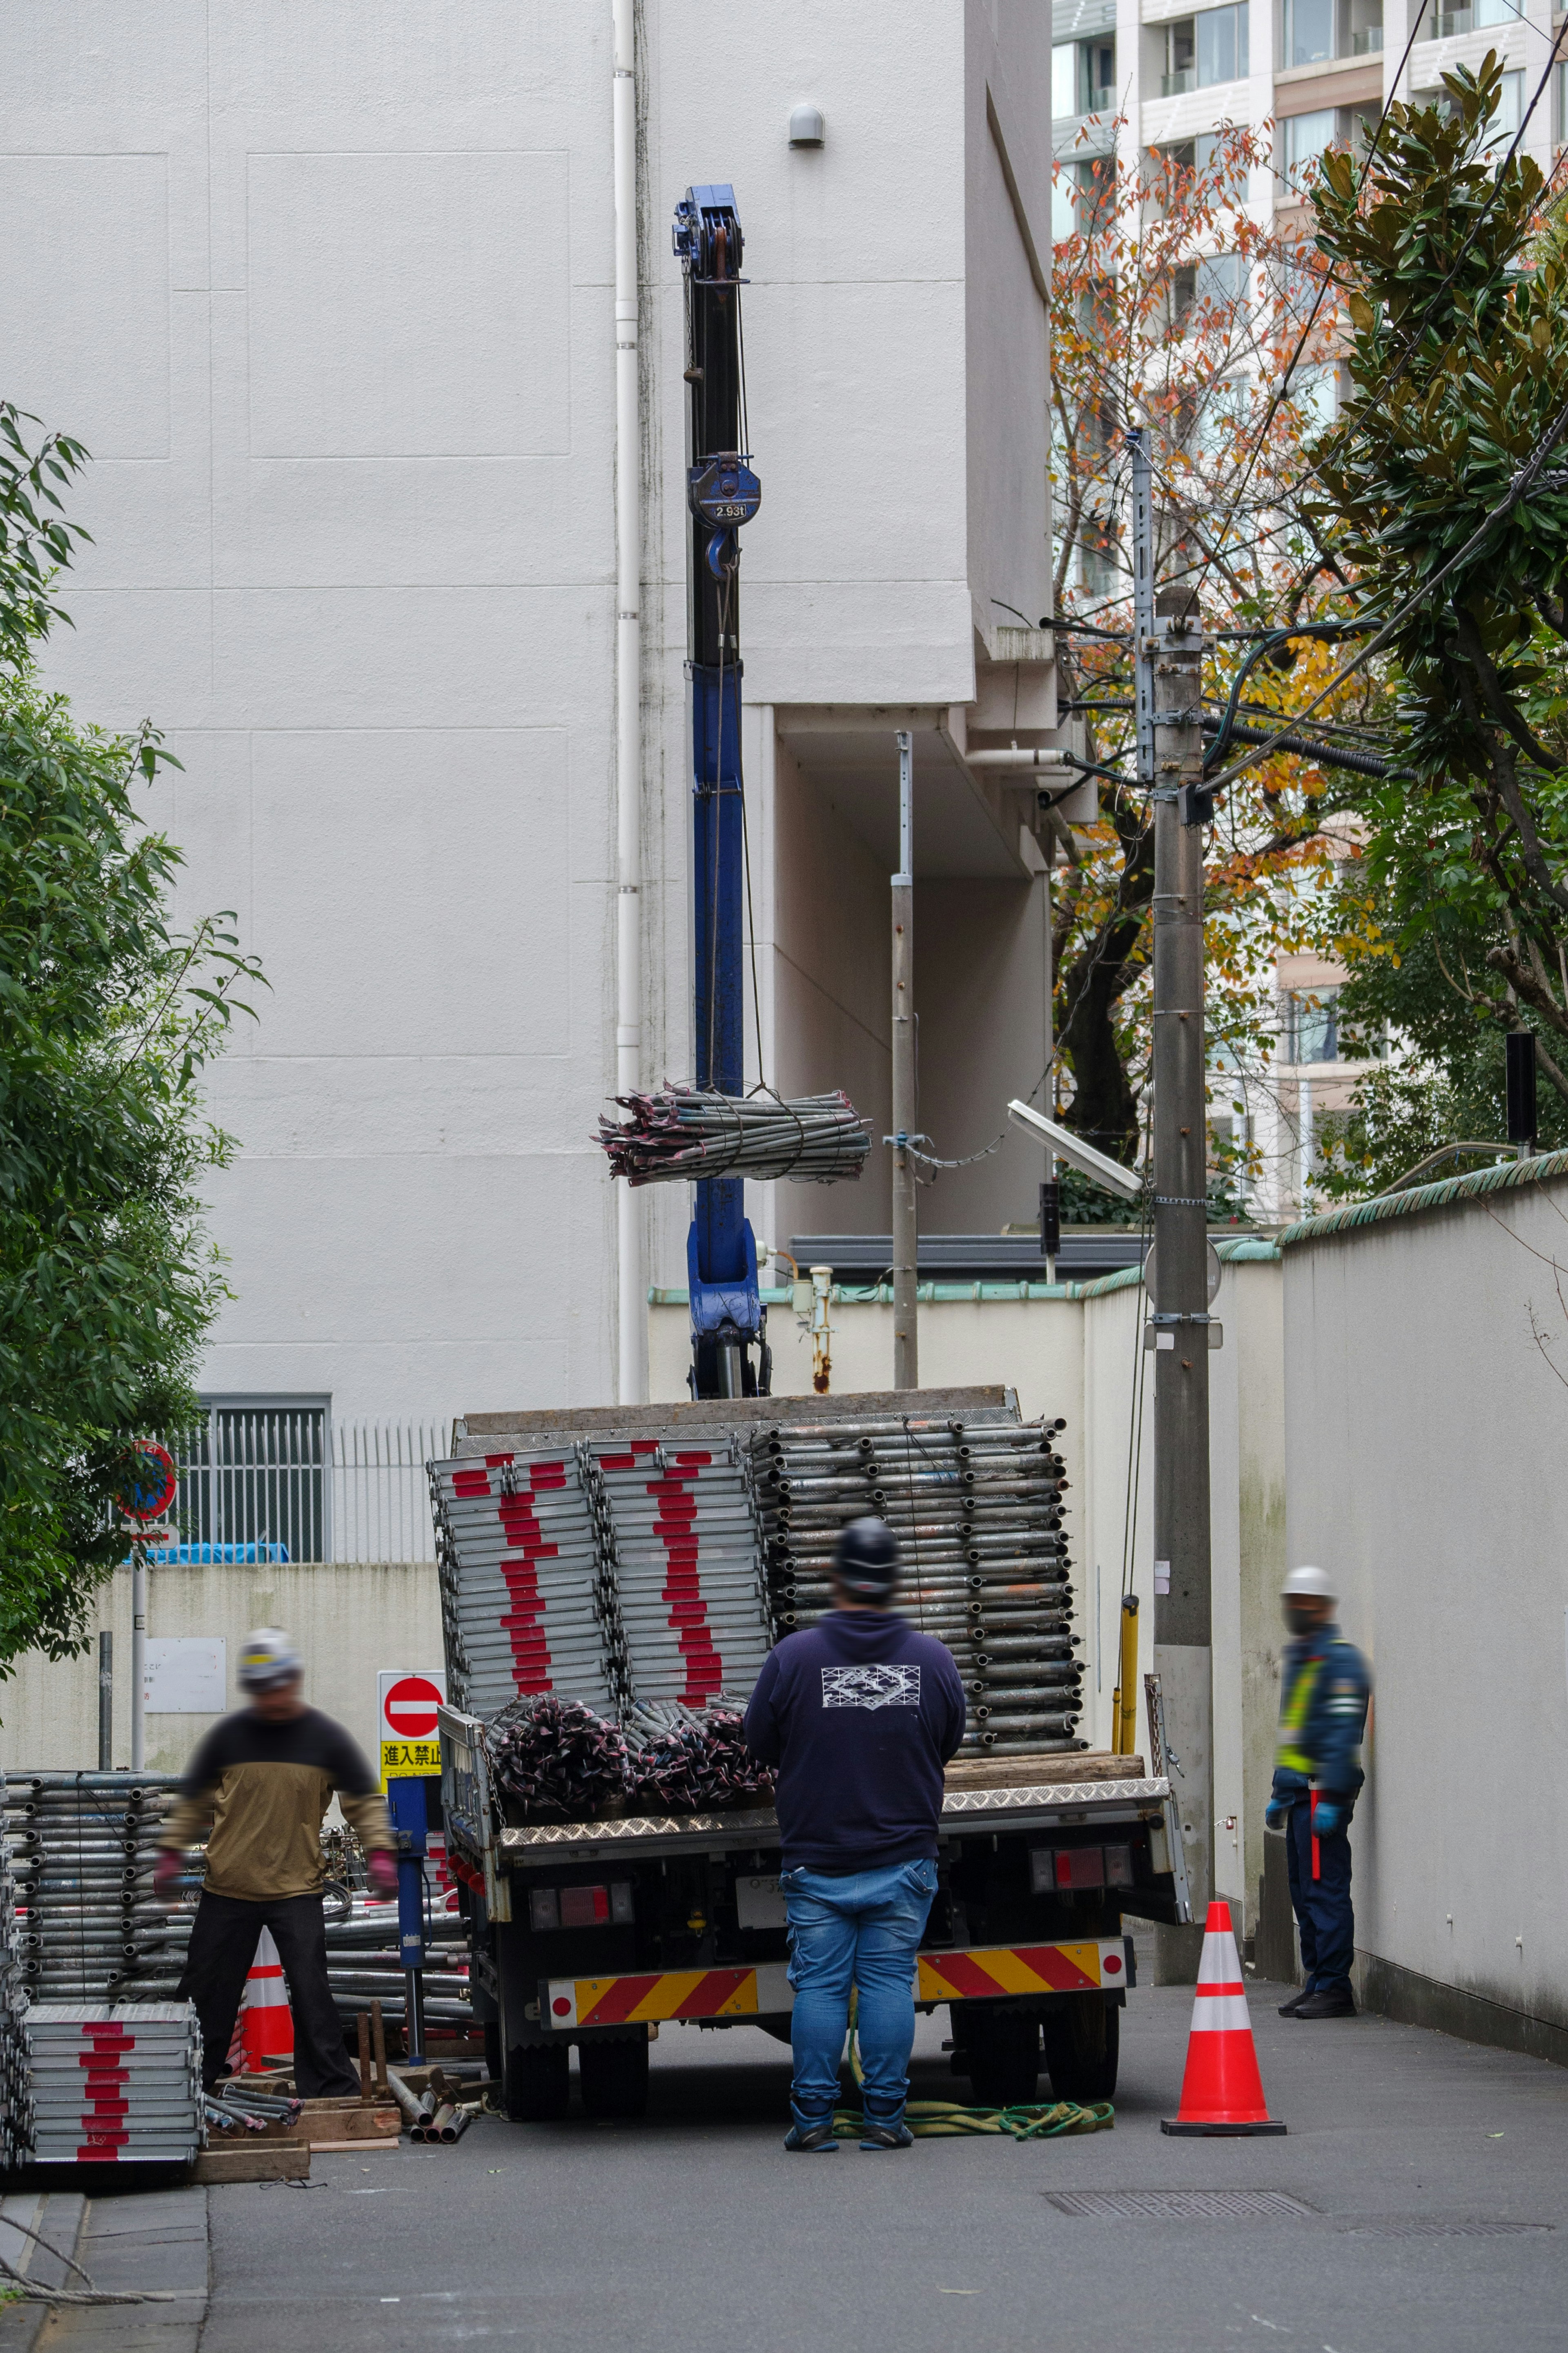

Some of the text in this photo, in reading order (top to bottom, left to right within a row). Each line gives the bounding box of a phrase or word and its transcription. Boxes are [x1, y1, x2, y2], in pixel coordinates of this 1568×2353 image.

[716, 506, 744, 517] 2.93t
[384, 1745, 441, 1766] 進入禁止
